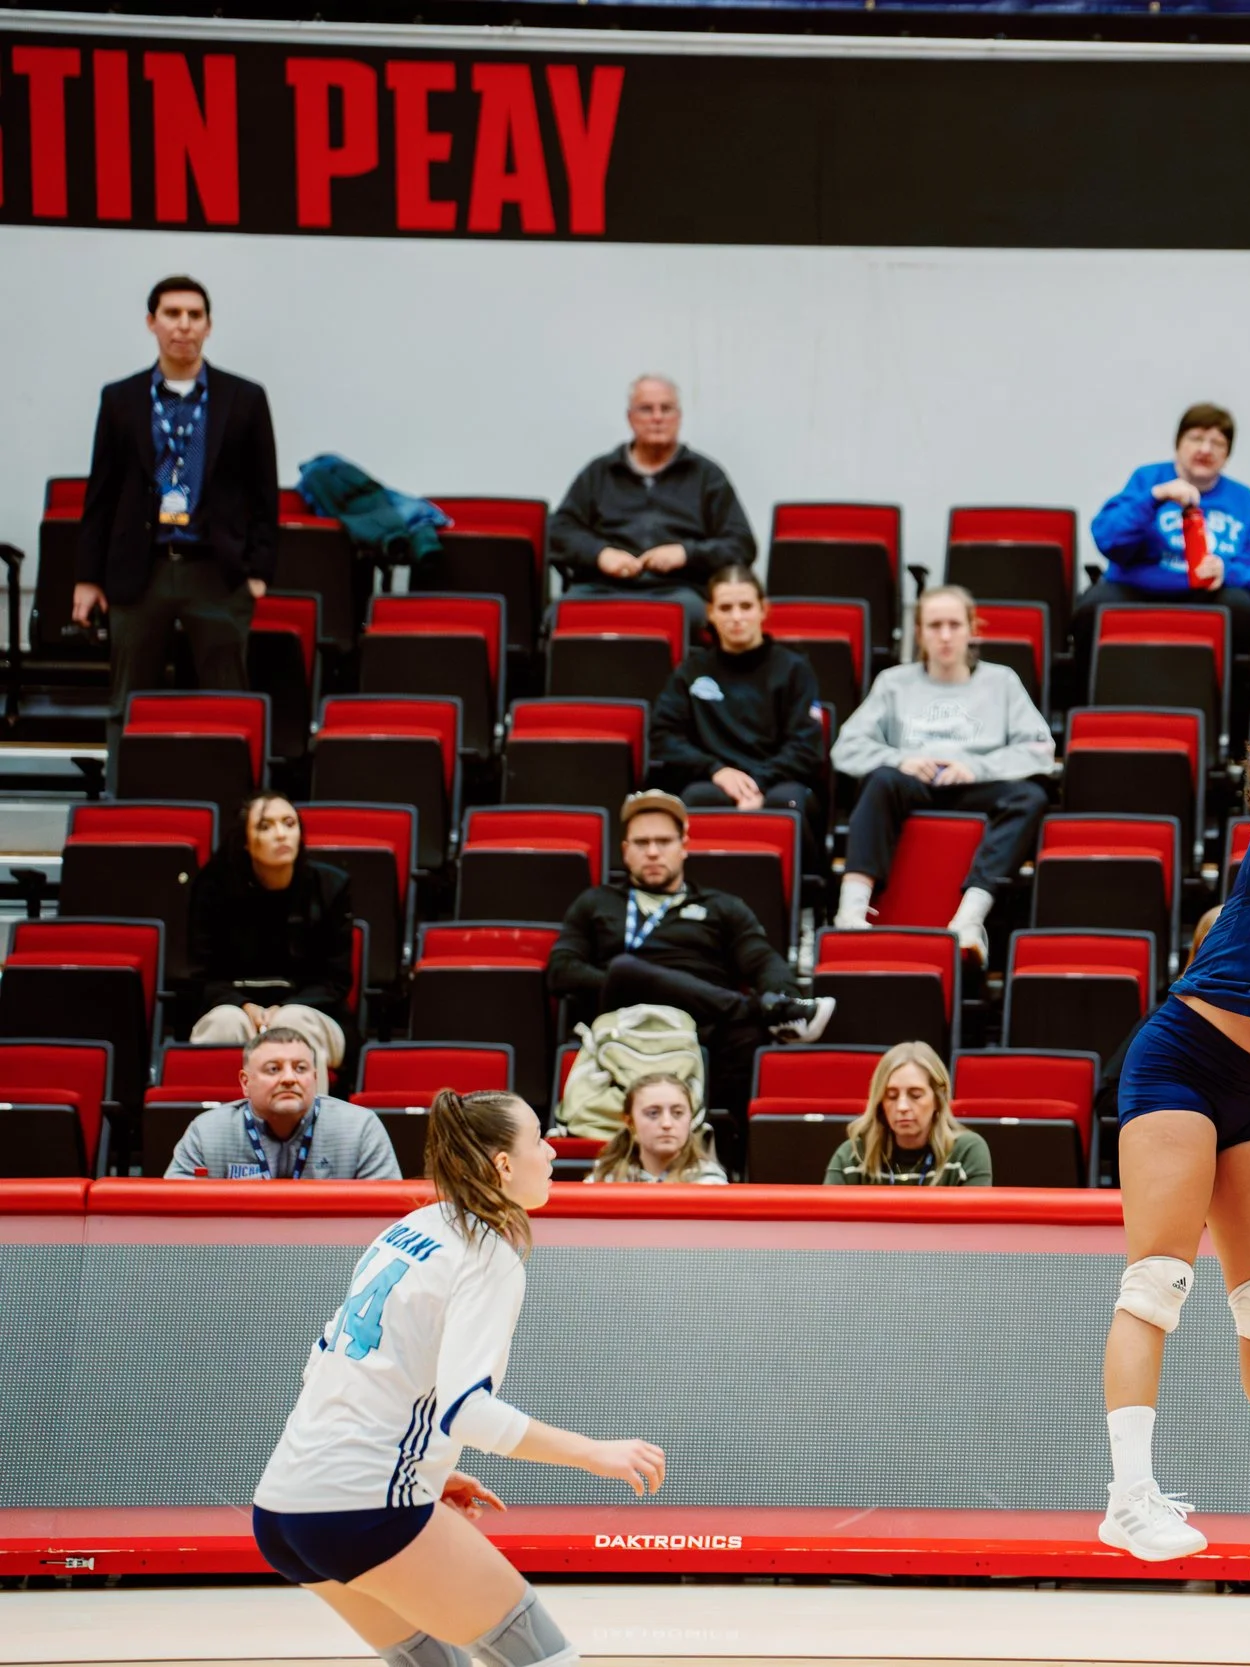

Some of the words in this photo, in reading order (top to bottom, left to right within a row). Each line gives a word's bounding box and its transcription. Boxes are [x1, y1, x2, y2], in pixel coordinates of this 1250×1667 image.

[0, 46, 240, 226] TIN
[286, 57, 626, 235] PEAY
[327, 1247, 410, 1361] 14
[594, 1534, 743, 1549] DAKTRONICS
